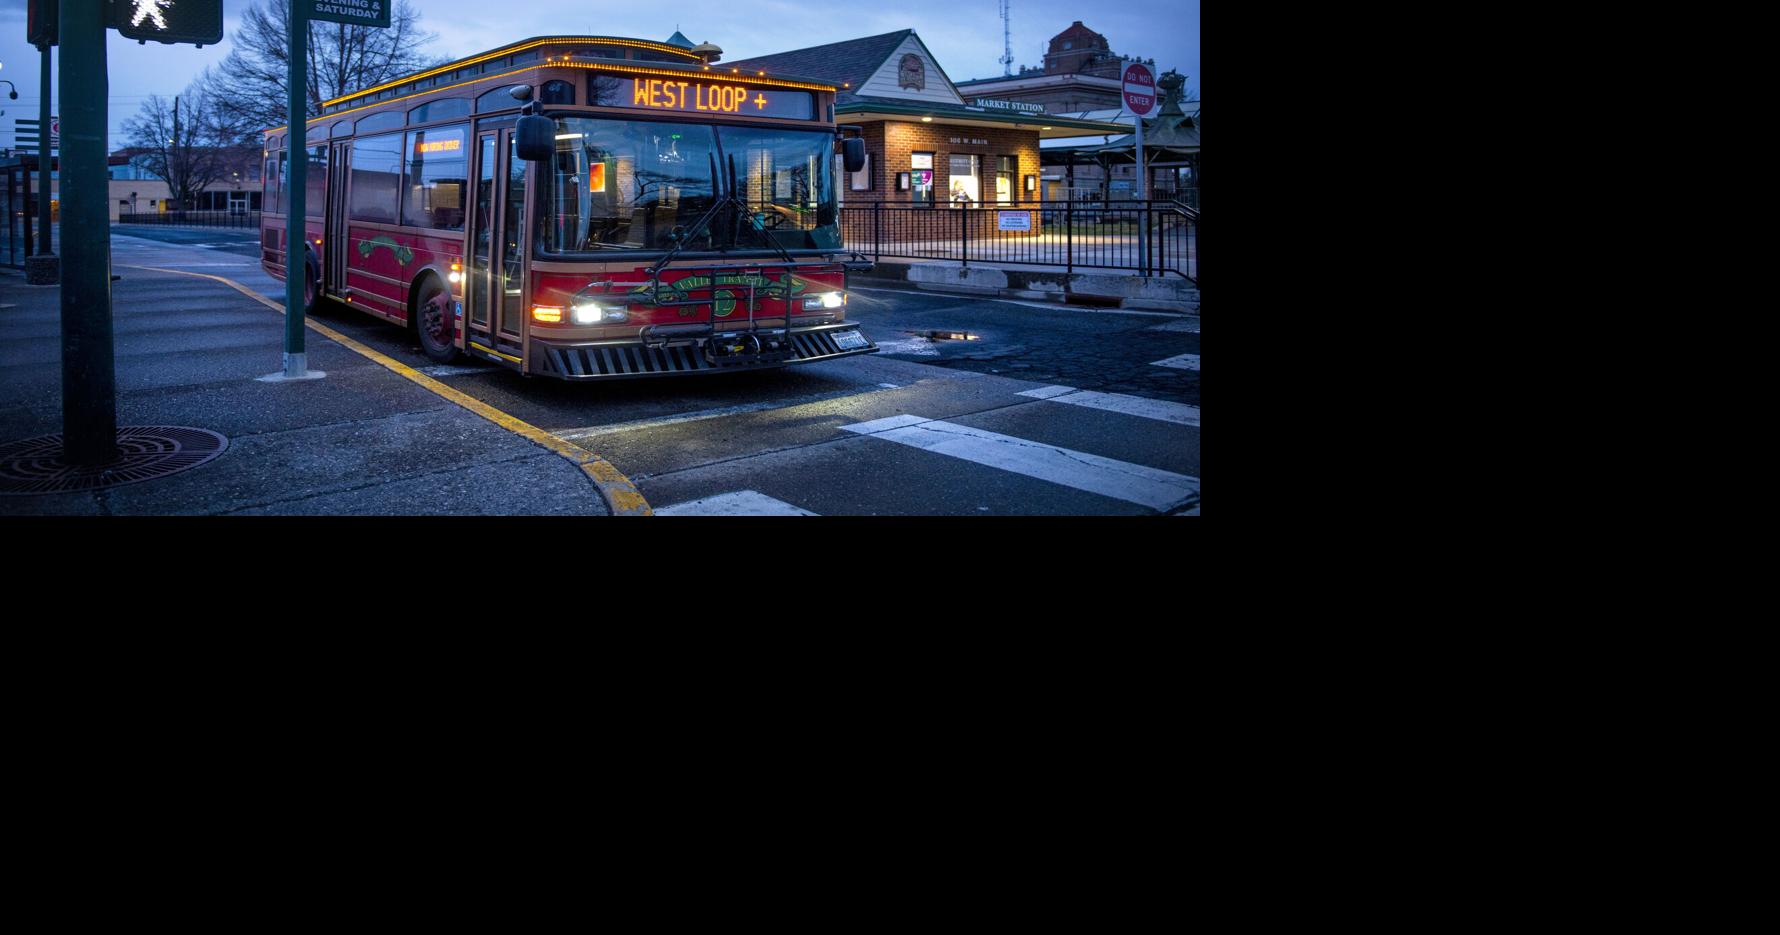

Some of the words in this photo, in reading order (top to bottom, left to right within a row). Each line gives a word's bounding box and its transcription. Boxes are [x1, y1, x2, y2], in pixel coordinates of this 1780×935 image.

[315, 3, 379, 19] SATURDAY
[371, 1, 381, 10] &
[1127, 72, 1136, 81] DO
[1140, 74, 1151, 84] NOT
[634, 78, 689, 107] WEST
[696, 83, 747, 112] LOOP
[1130, 95, 1149, 106] ENTER
[977, 98, 1010, 109] MARKET
[1011, 102, 1044, 112] STATION
[679, 276, 713, 290] VALLE
